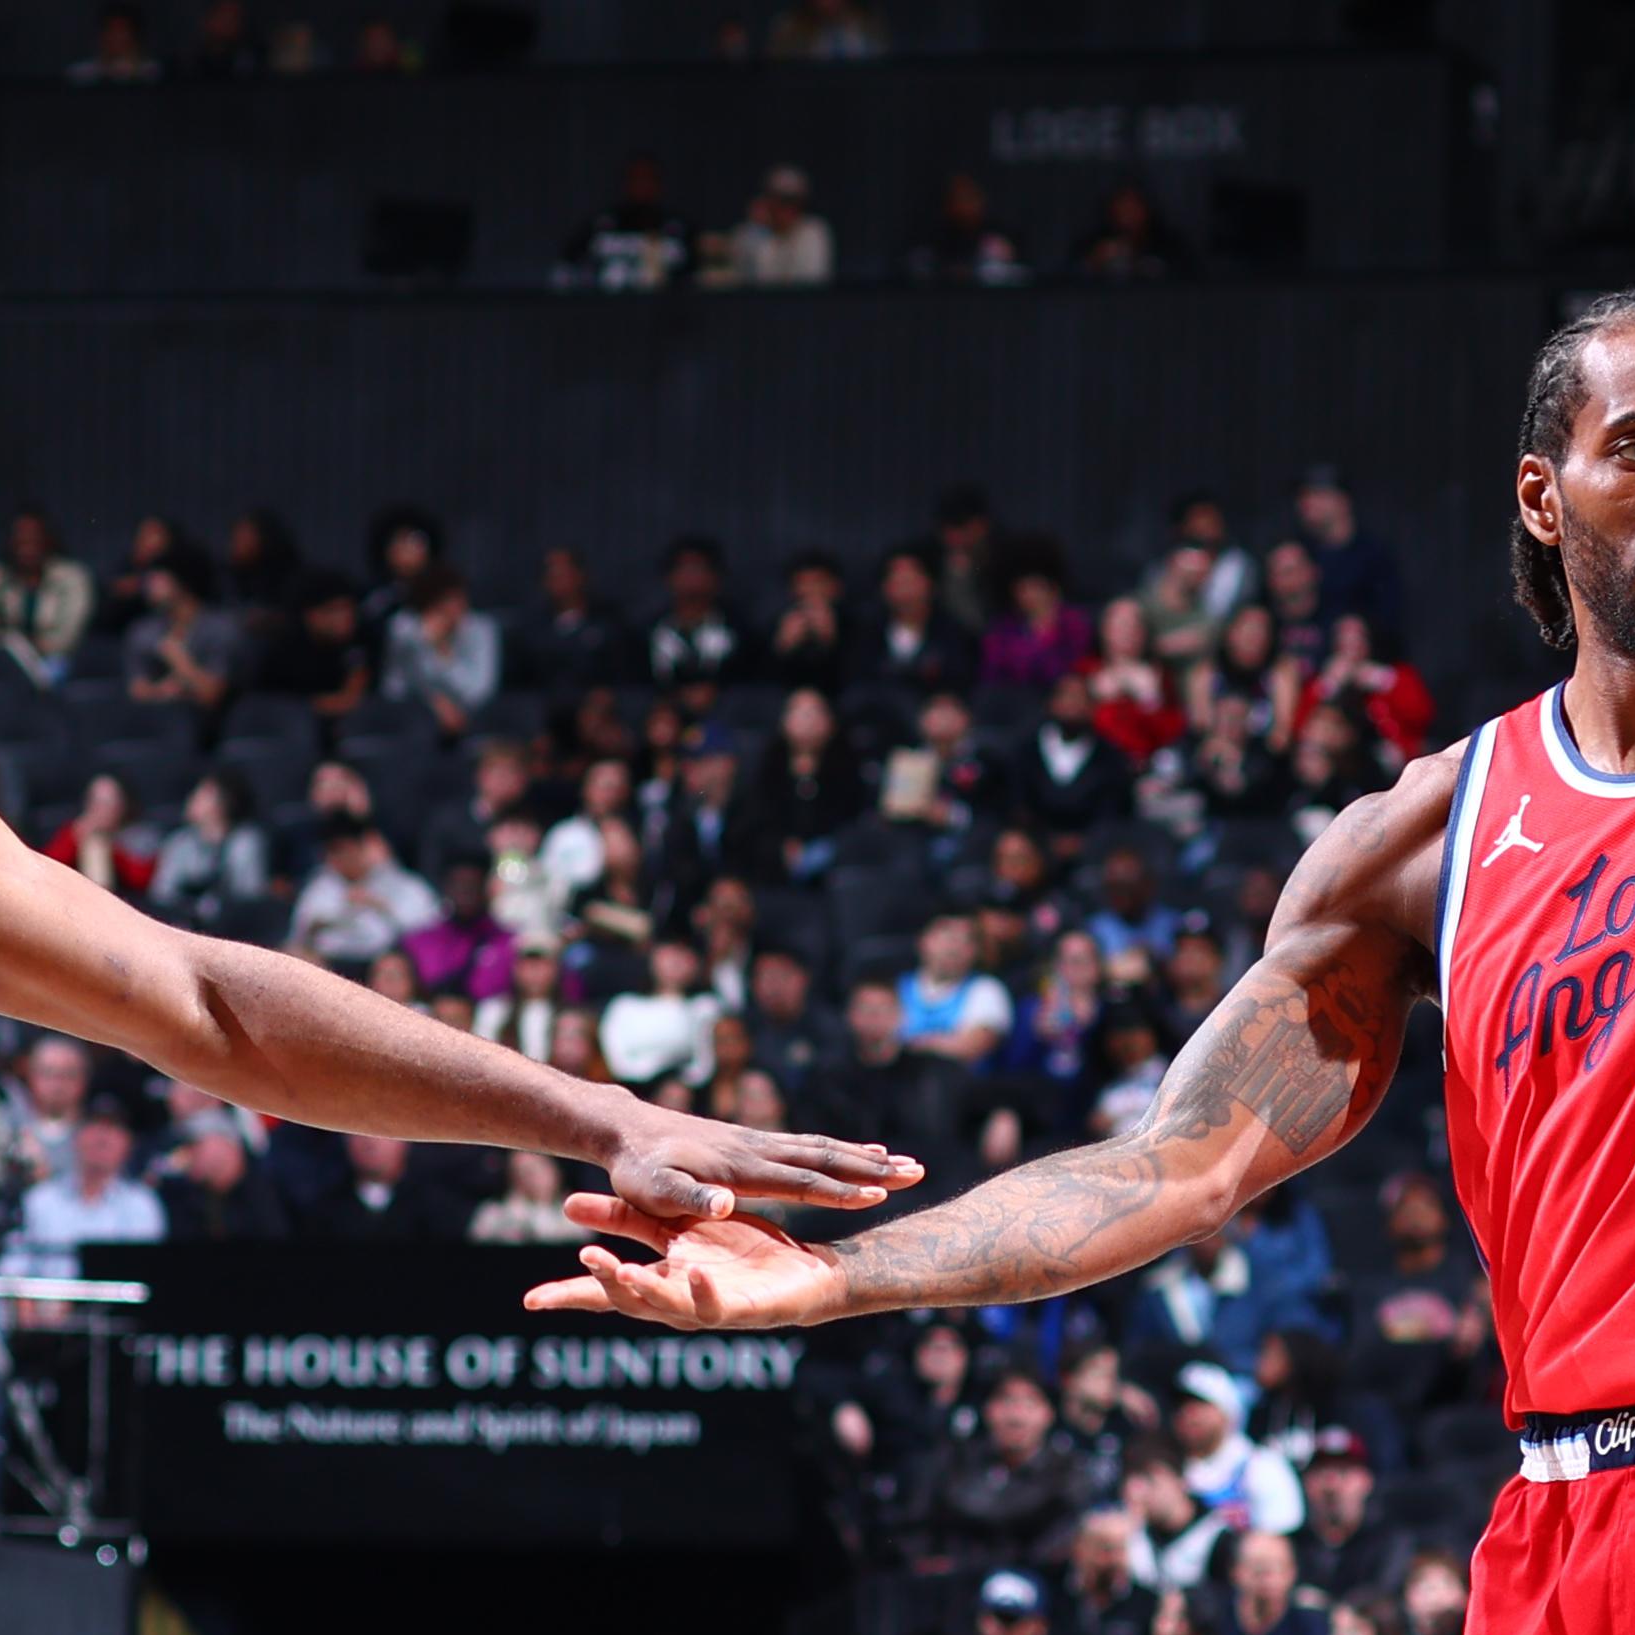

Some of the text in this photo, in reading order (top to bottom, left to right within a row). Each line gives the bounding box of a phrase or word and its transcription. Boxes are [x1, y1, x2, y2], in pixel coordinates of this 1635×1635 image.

[243, 1334, 437, 1389] HOUSE
[445, 1334, 523, 1389] OF
[531, 1334, 802, 1390] SUNTORY
